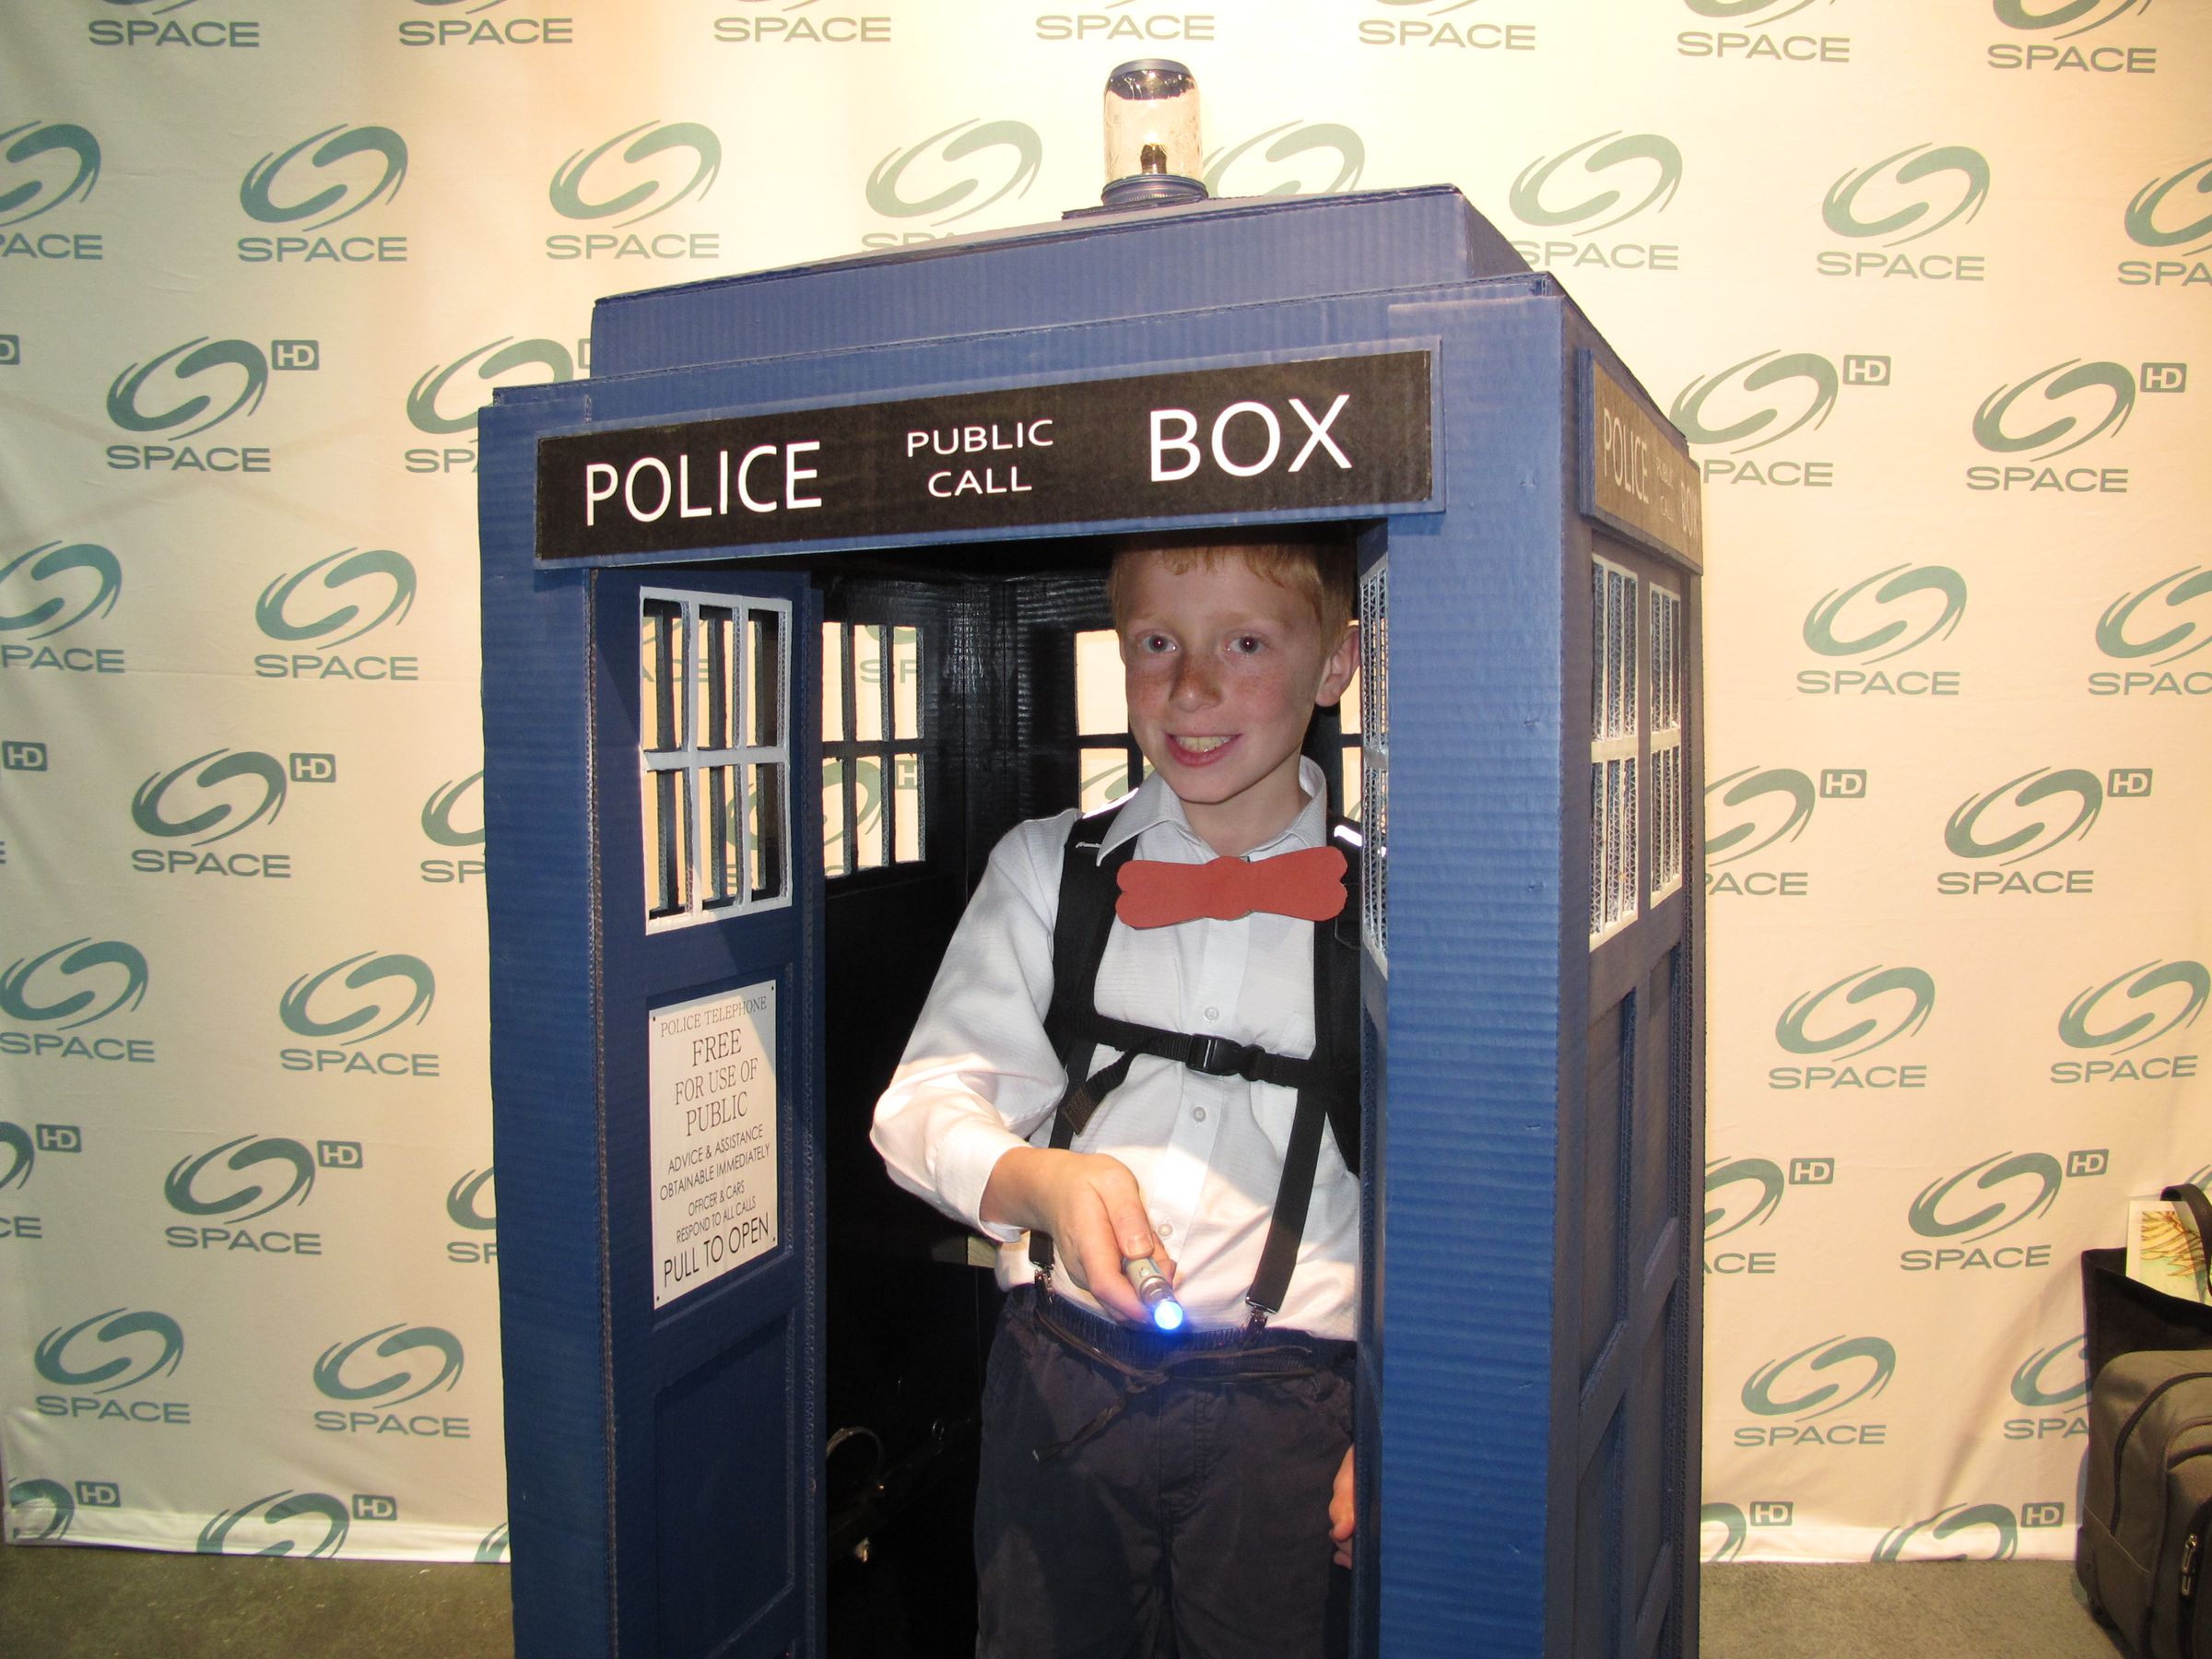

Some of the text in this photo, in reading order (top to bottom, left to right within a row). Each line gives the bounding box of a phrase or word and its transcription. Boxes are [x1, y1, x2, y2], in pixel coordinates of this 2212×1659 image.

[88, 19, 258, 47] SPACE
[398, 18, 571, 46] SPACE
[714, 17, 890, 41] SPACE
[1036, 15, 1214, 41] SPACE
[1359, 20, 1535, 50] SPACE
[1677, 32, 1850, 63] SPACE
[1988, 44, 2158, 74] SPACE
[0, 234, 102, 260] ACE
[236, 237, 406, 262] SPACE
[546, 234, 719, 259] SPACE
[1512, 241, 1679, 270] SPACE
[1818, 252, 1984, 281] SPACE
[2117, 261, 2212, 286] SPA
[275, 343, 316, 367] HD
[1846, 358, 1888, 382] HD
[2144, 366, 2183, 390] HD
[907, 419, 1053, 457] PUBLIC
[1150, 394, 1352, 482] BOX
[106, 445, 269, 472] SPACE
[1604, 406, 1649, 504] POLICE
[586, 441, 821, 526] POLICE
[928, 466, 1032, 497] CALL
[1702, 459, 1833, 487] PACE
[1967, 466, 2128, 492] SPACE
[0, 646, 125, 673] PACE
[253, 654, 418, 680] SPACE
[1797, 670, 1960, 695] SPACE
[2088, 672, 2212, 696] SPAC
[6, 744, 44, 769] HD
[293, 756, 333, 780] HD
[1823, 771, 1864, 795] HD
[2111, 771, 2149, 794] HD
[131, 849, 289, 877] SPACE
[1705, 872, 1808, 896] ACE
[1938, 870, 2094, 894] SPACE
[661, 996, 767, 1038] POLICE TELEPHONE
[0, 1031, 155, 1063] SPACE
[692, 1029, 742, 1066] FREE
[280, 1049, 439, 1077] SPACE
[2051, 1055, 2198, 1083] SPACE
[675, 1057, 758, 1105] FOR USE OF
[1769, 1065, 1927, 1089] SPACE
[687, 1091, 747, 1136] PUBLIC
[39, 1126, 78, 1149] HD
[668, 1124, 763, 1174] ADVICE & ASSISTANCE
[320, 1144, 359, 1166] HD
[2070, 1152, 2106, 1174] HD
[660, 1143, 771, 1201] OBTAINABLE IMMEDIATELY
[1793, 1160, 1831, 1182] HD
[688, 1180, 745, 1216] OFFICER & CARS
[677, 1195, 756, 1244] RESPOND TO ALL CALLS
[165, 1226, 321, 1254] SPACE
[664, 1212, 769, 1288] PULL TO OPEN
[1900, 1245, 2051, 1271] SPACE
[35, 1395, 190, 1424] SPACE
[313, 1411, 470, 1438] SPACE
[1735, 1425, 1887, 1447] SPACE
[2004, 1417, 2089, 1441] SPA
[78, 1484, 118, 1504] HD
[356, 1497, 394, 1519] HD
[1753, 1504, 1790, 1524] HD
[2024, 1505, 2061, 1524] HD
